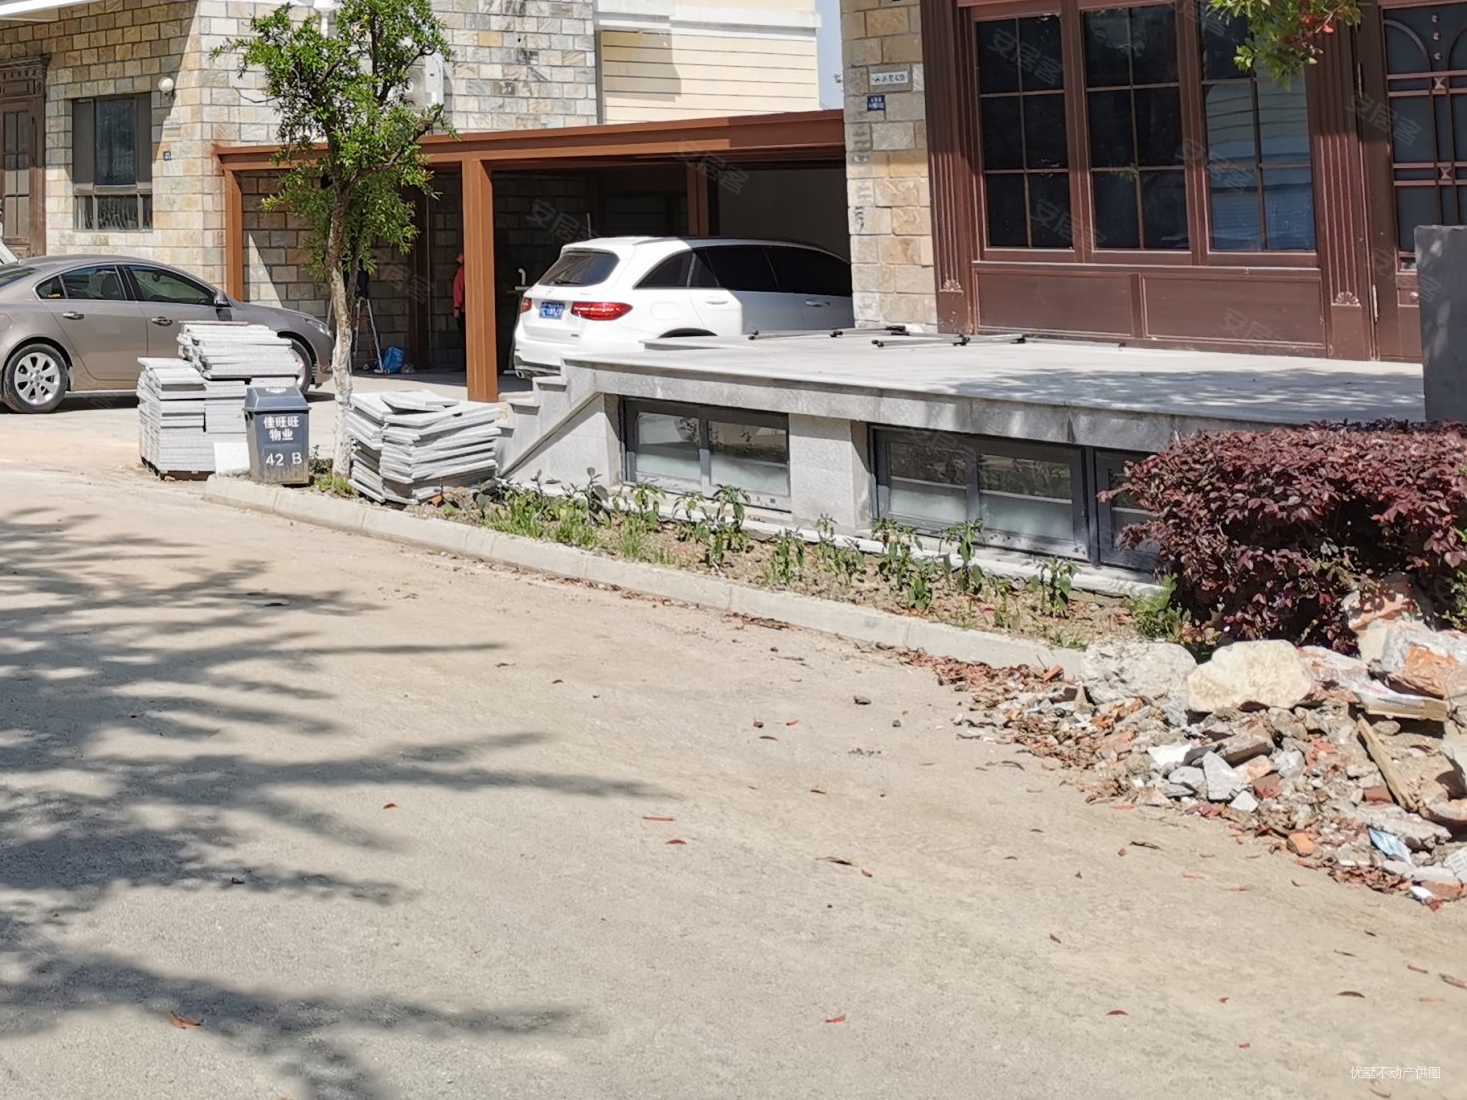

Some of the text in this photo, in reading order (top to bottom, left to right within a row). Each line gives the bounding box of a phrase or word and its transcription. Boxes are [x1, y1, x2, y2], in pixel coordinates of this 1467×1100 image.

[263, 416, 299, 428] 佳旺旺
[269, 428, 294, 441] 物业
[265, 452, 303, 466] 42 B
